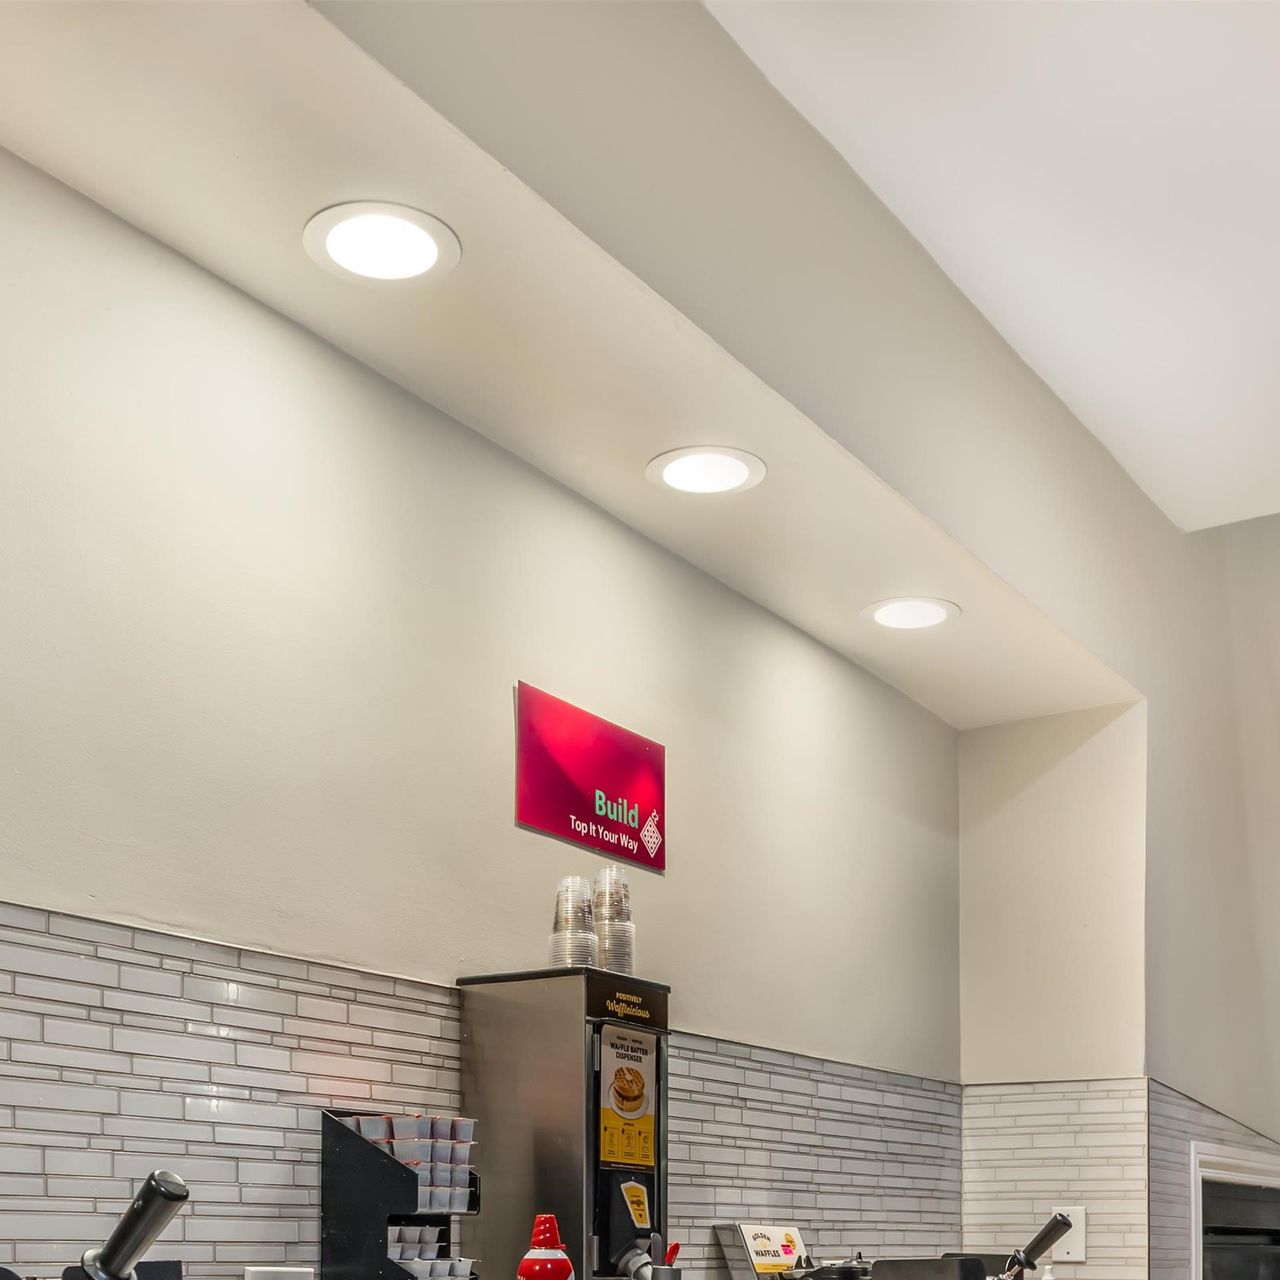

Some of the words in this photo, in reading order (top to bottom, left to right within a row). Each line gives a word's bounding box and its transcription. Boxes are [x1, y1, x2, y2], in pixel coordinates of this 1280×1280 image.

[595, 789, 639, 829] Build
[569, 814, 588, 836] Top
[589, 821, 597, 837] It
[597, 824, 619, 844] Your
[619, 832, 639, 854] Way
[615, 991, 643, 1004] POSITIVELY
[609, 1041, 630, 1053] WAFFLE
[630, 1046, 649, 1056] BATTER
[615, 1050, 643, 1063] DISPENSER
[751, 1232, 771, 1242] GOLDEN
[753, 1249, 781, 1258] WAFFLES
